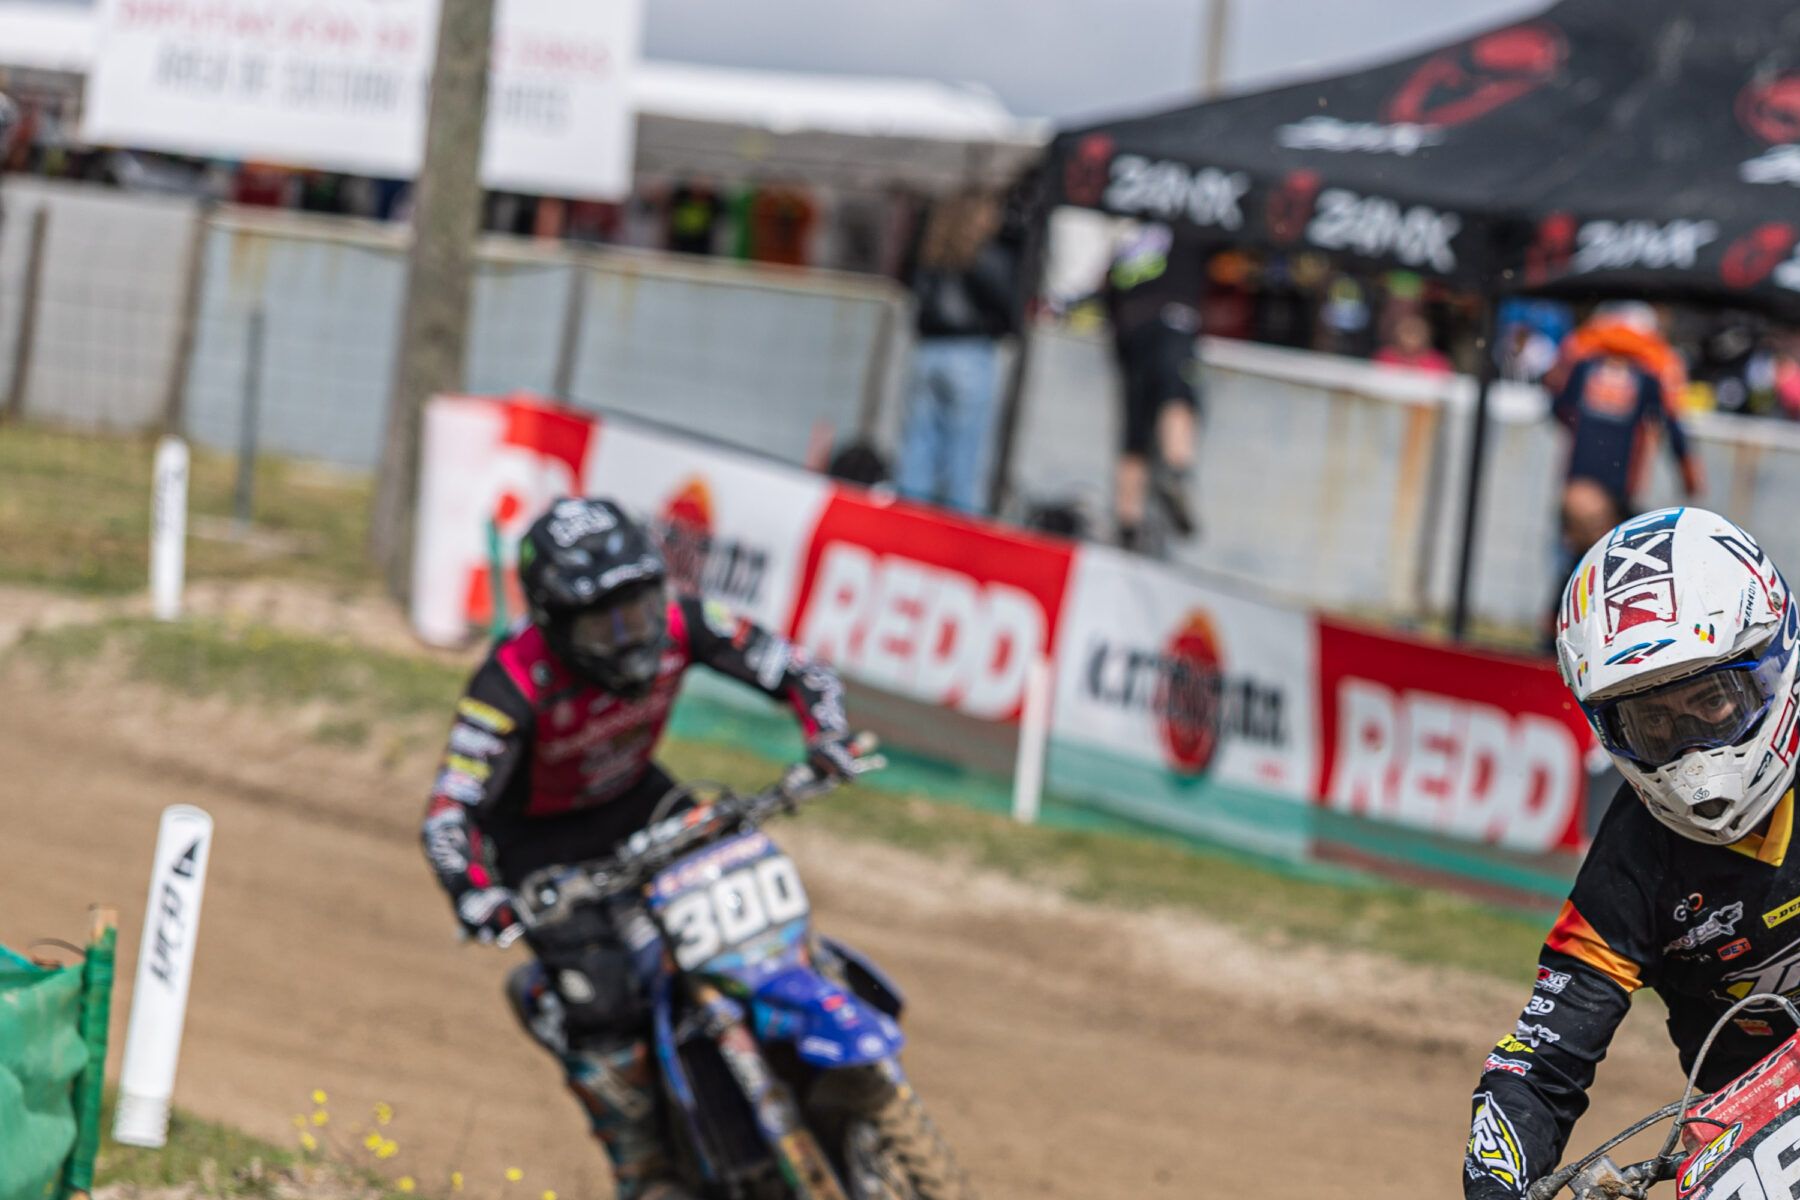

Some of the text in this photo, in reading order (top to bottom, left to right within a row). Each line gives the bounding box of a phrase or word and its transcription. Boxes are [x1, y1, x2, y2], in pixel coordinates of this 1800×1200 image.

[804, 537, 1048, 722] REDD
[1324, 674, 1582, 853] REDD
[662, 855, 811, 972] 300
